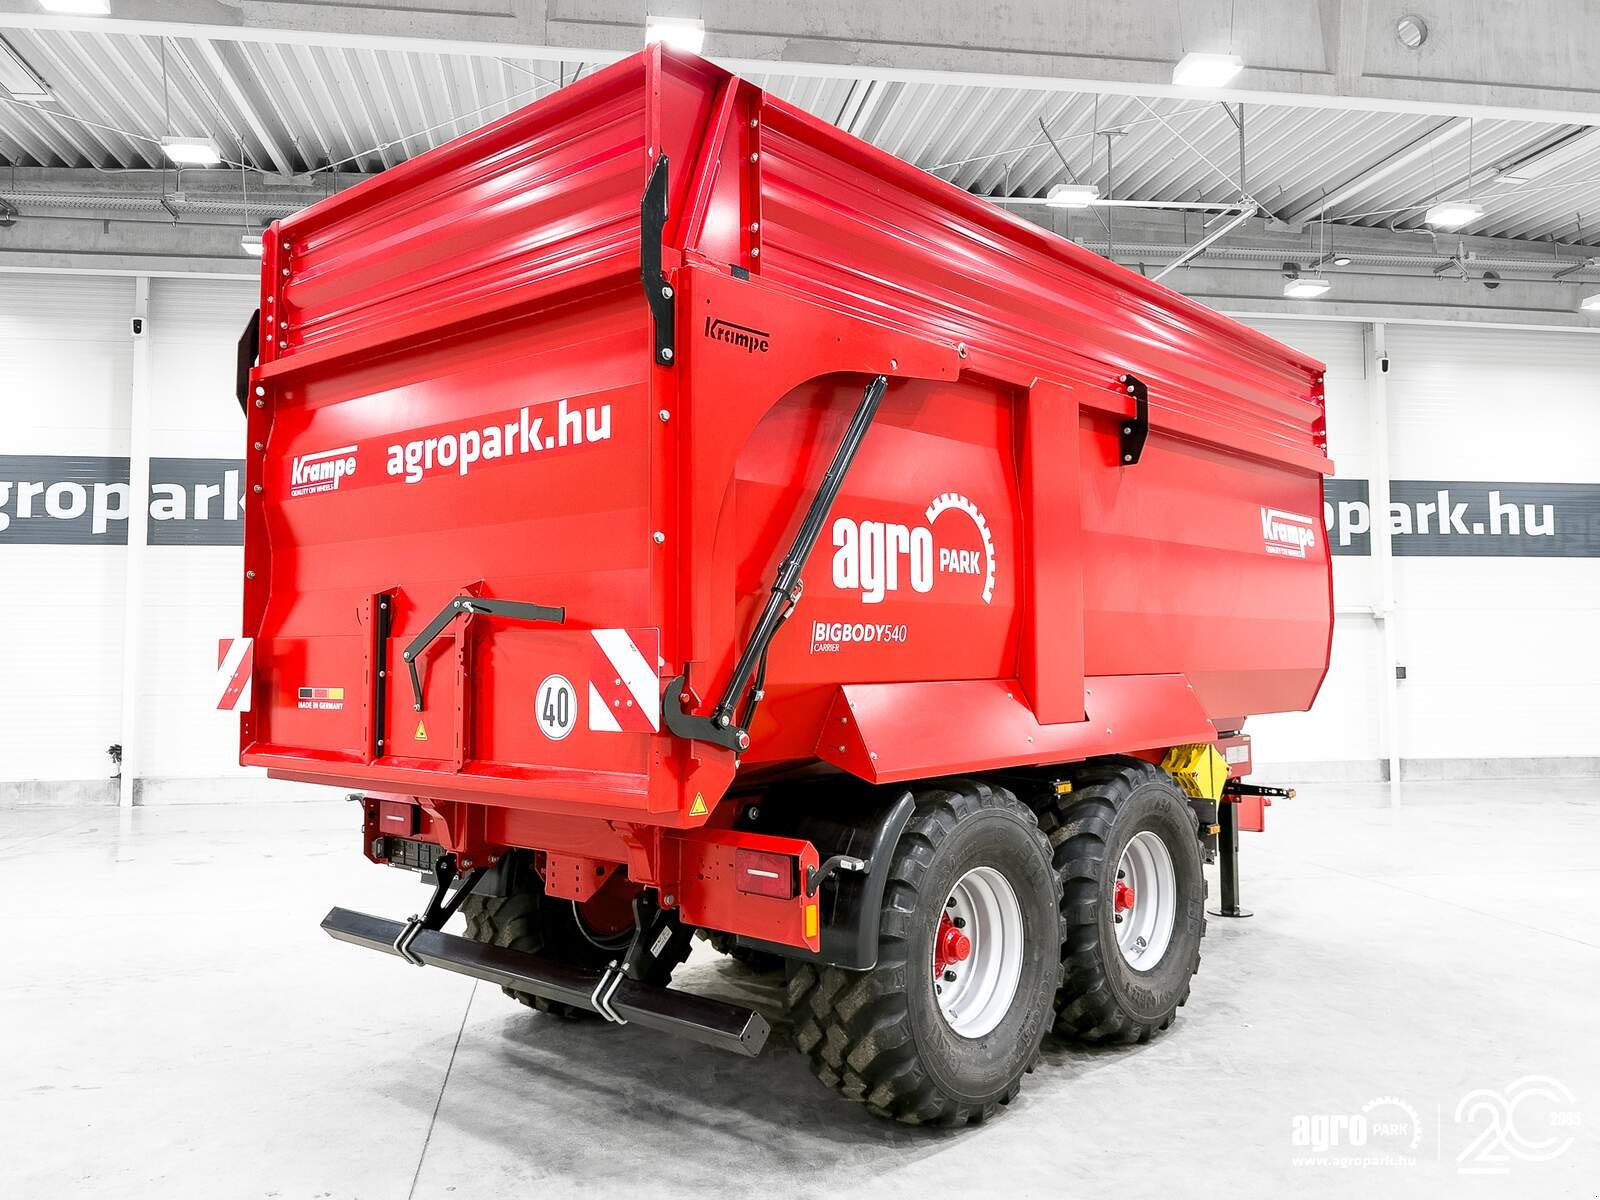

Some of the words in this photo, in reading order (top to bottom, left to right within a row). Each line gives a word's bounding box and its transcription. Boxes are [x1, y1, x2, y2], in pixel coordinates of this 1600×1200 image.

[704, 315, 770, 354] Krampe
[386, 399, 612, 484] agropark.hu
[291, 444, 359, 490] Krampe
[1260, 507, 1315, 559] Krampe
[832, 517, 934, 604] agro
[939, 547, 981, 575] PARK
[813, 643, 840, 653] CARRIER
[814, 622, 908, 643] BIGBODY540
[298, 701, 312, 709] MADE
[319, 702, 344, 710] GERMANY
[543, 687, 569, 728] 40
